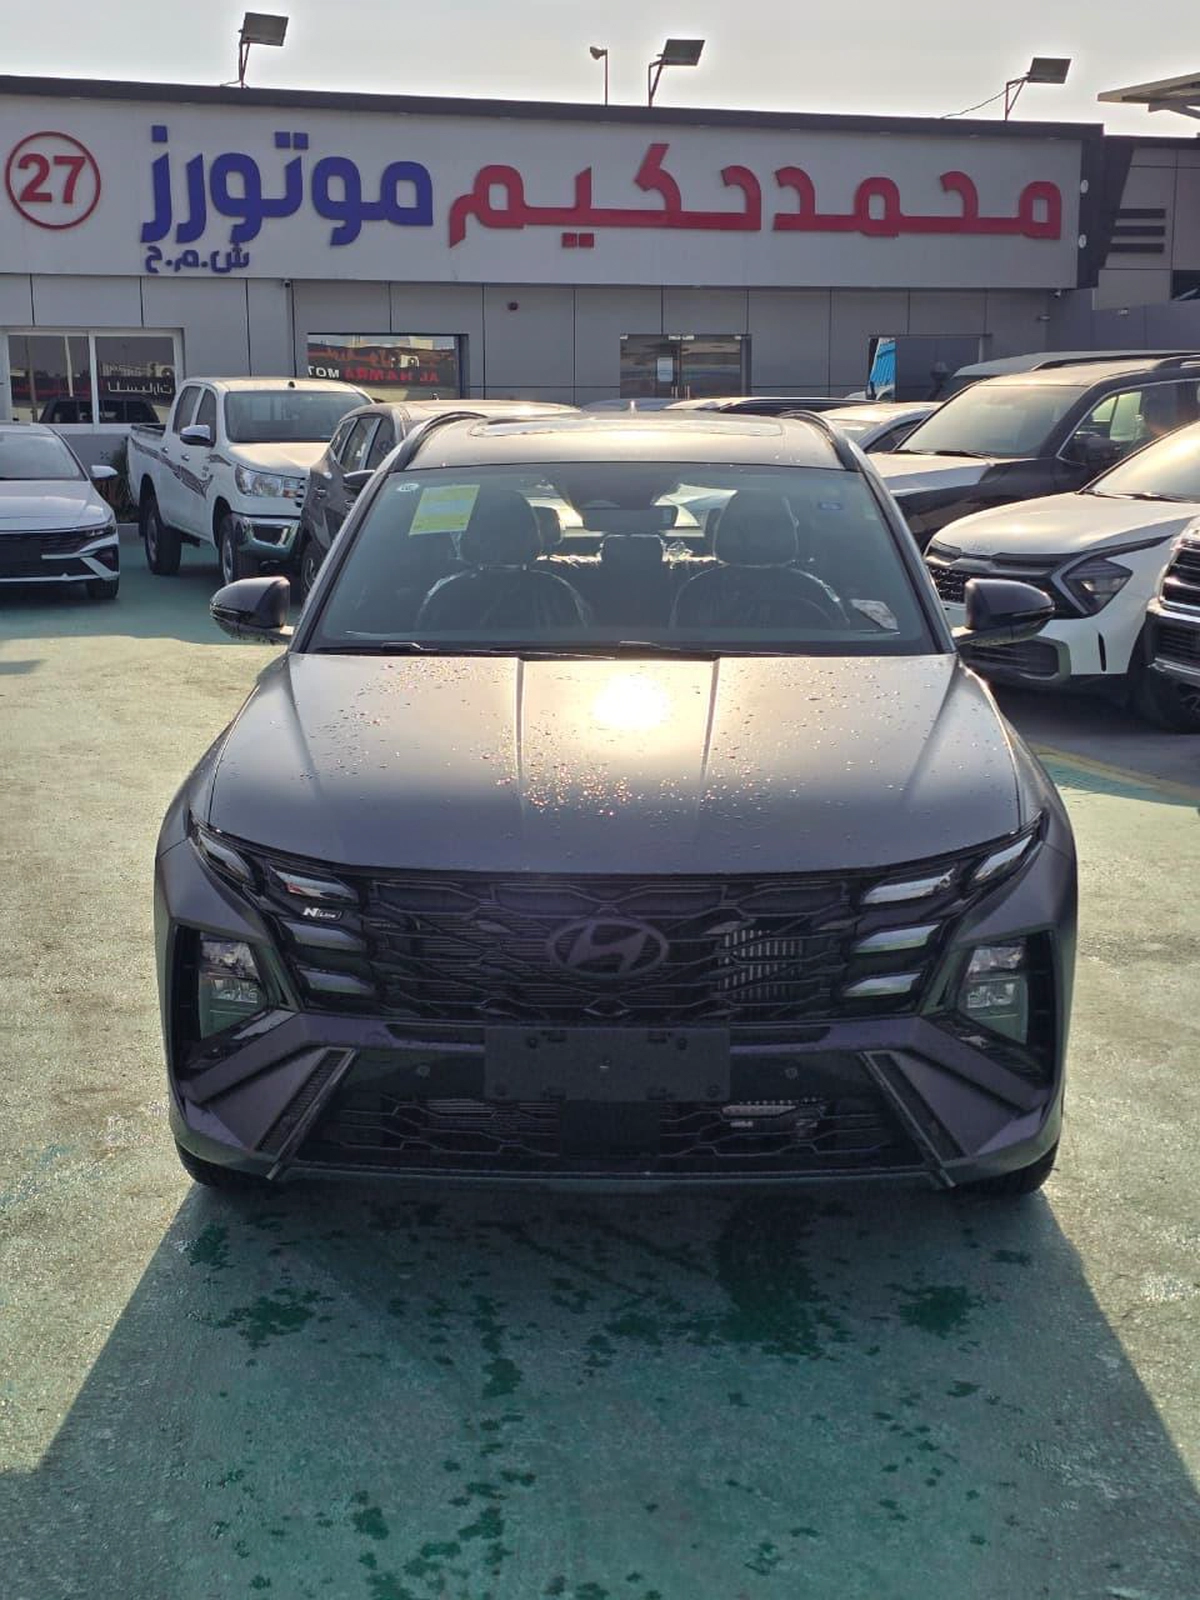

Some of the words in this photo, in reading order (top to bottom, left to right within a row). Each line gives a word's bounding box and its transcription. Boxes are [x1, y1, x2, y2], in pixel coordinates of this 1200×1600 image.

[16, 153, 88, 205] 27
[140, 125, 434, 247] موتورز
[448, 143, 762, 249] حكيم
[773, 166, 1062, 240] محمد
